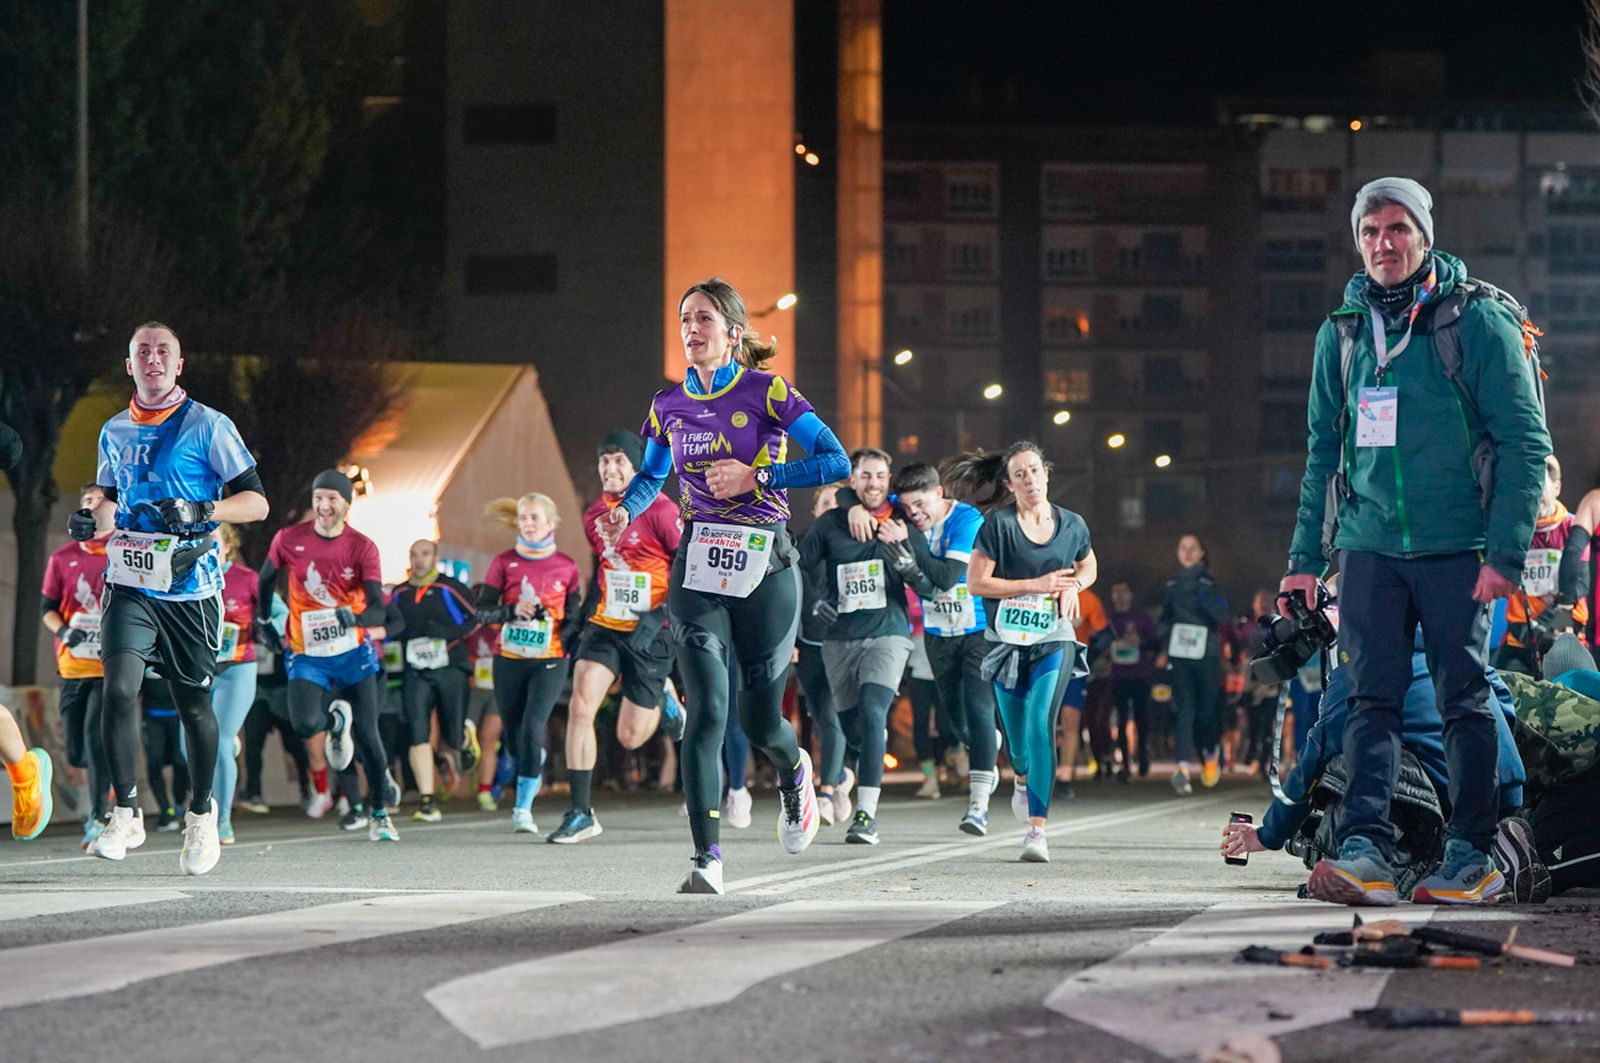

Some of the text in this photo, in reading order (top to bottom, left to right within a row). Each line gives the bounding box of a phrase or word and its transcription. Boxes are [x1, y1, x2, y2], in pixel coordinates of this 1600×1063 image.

[688, 432, 714, 443] FUEGO
[682, 443, 710, 456] TEAM
[733, 533, 743, 541] DE
[123, 549, 153, 570] 550
[708, 546, 748, 572] 959
[933, 600, 962, 614] 3176
[1005, 608, 1050, 629] 12643
[312, 625, 347, 642] 5390
[509, 627, 545, 645] 13928
[1462, 867, 1485, 887] HOKA
